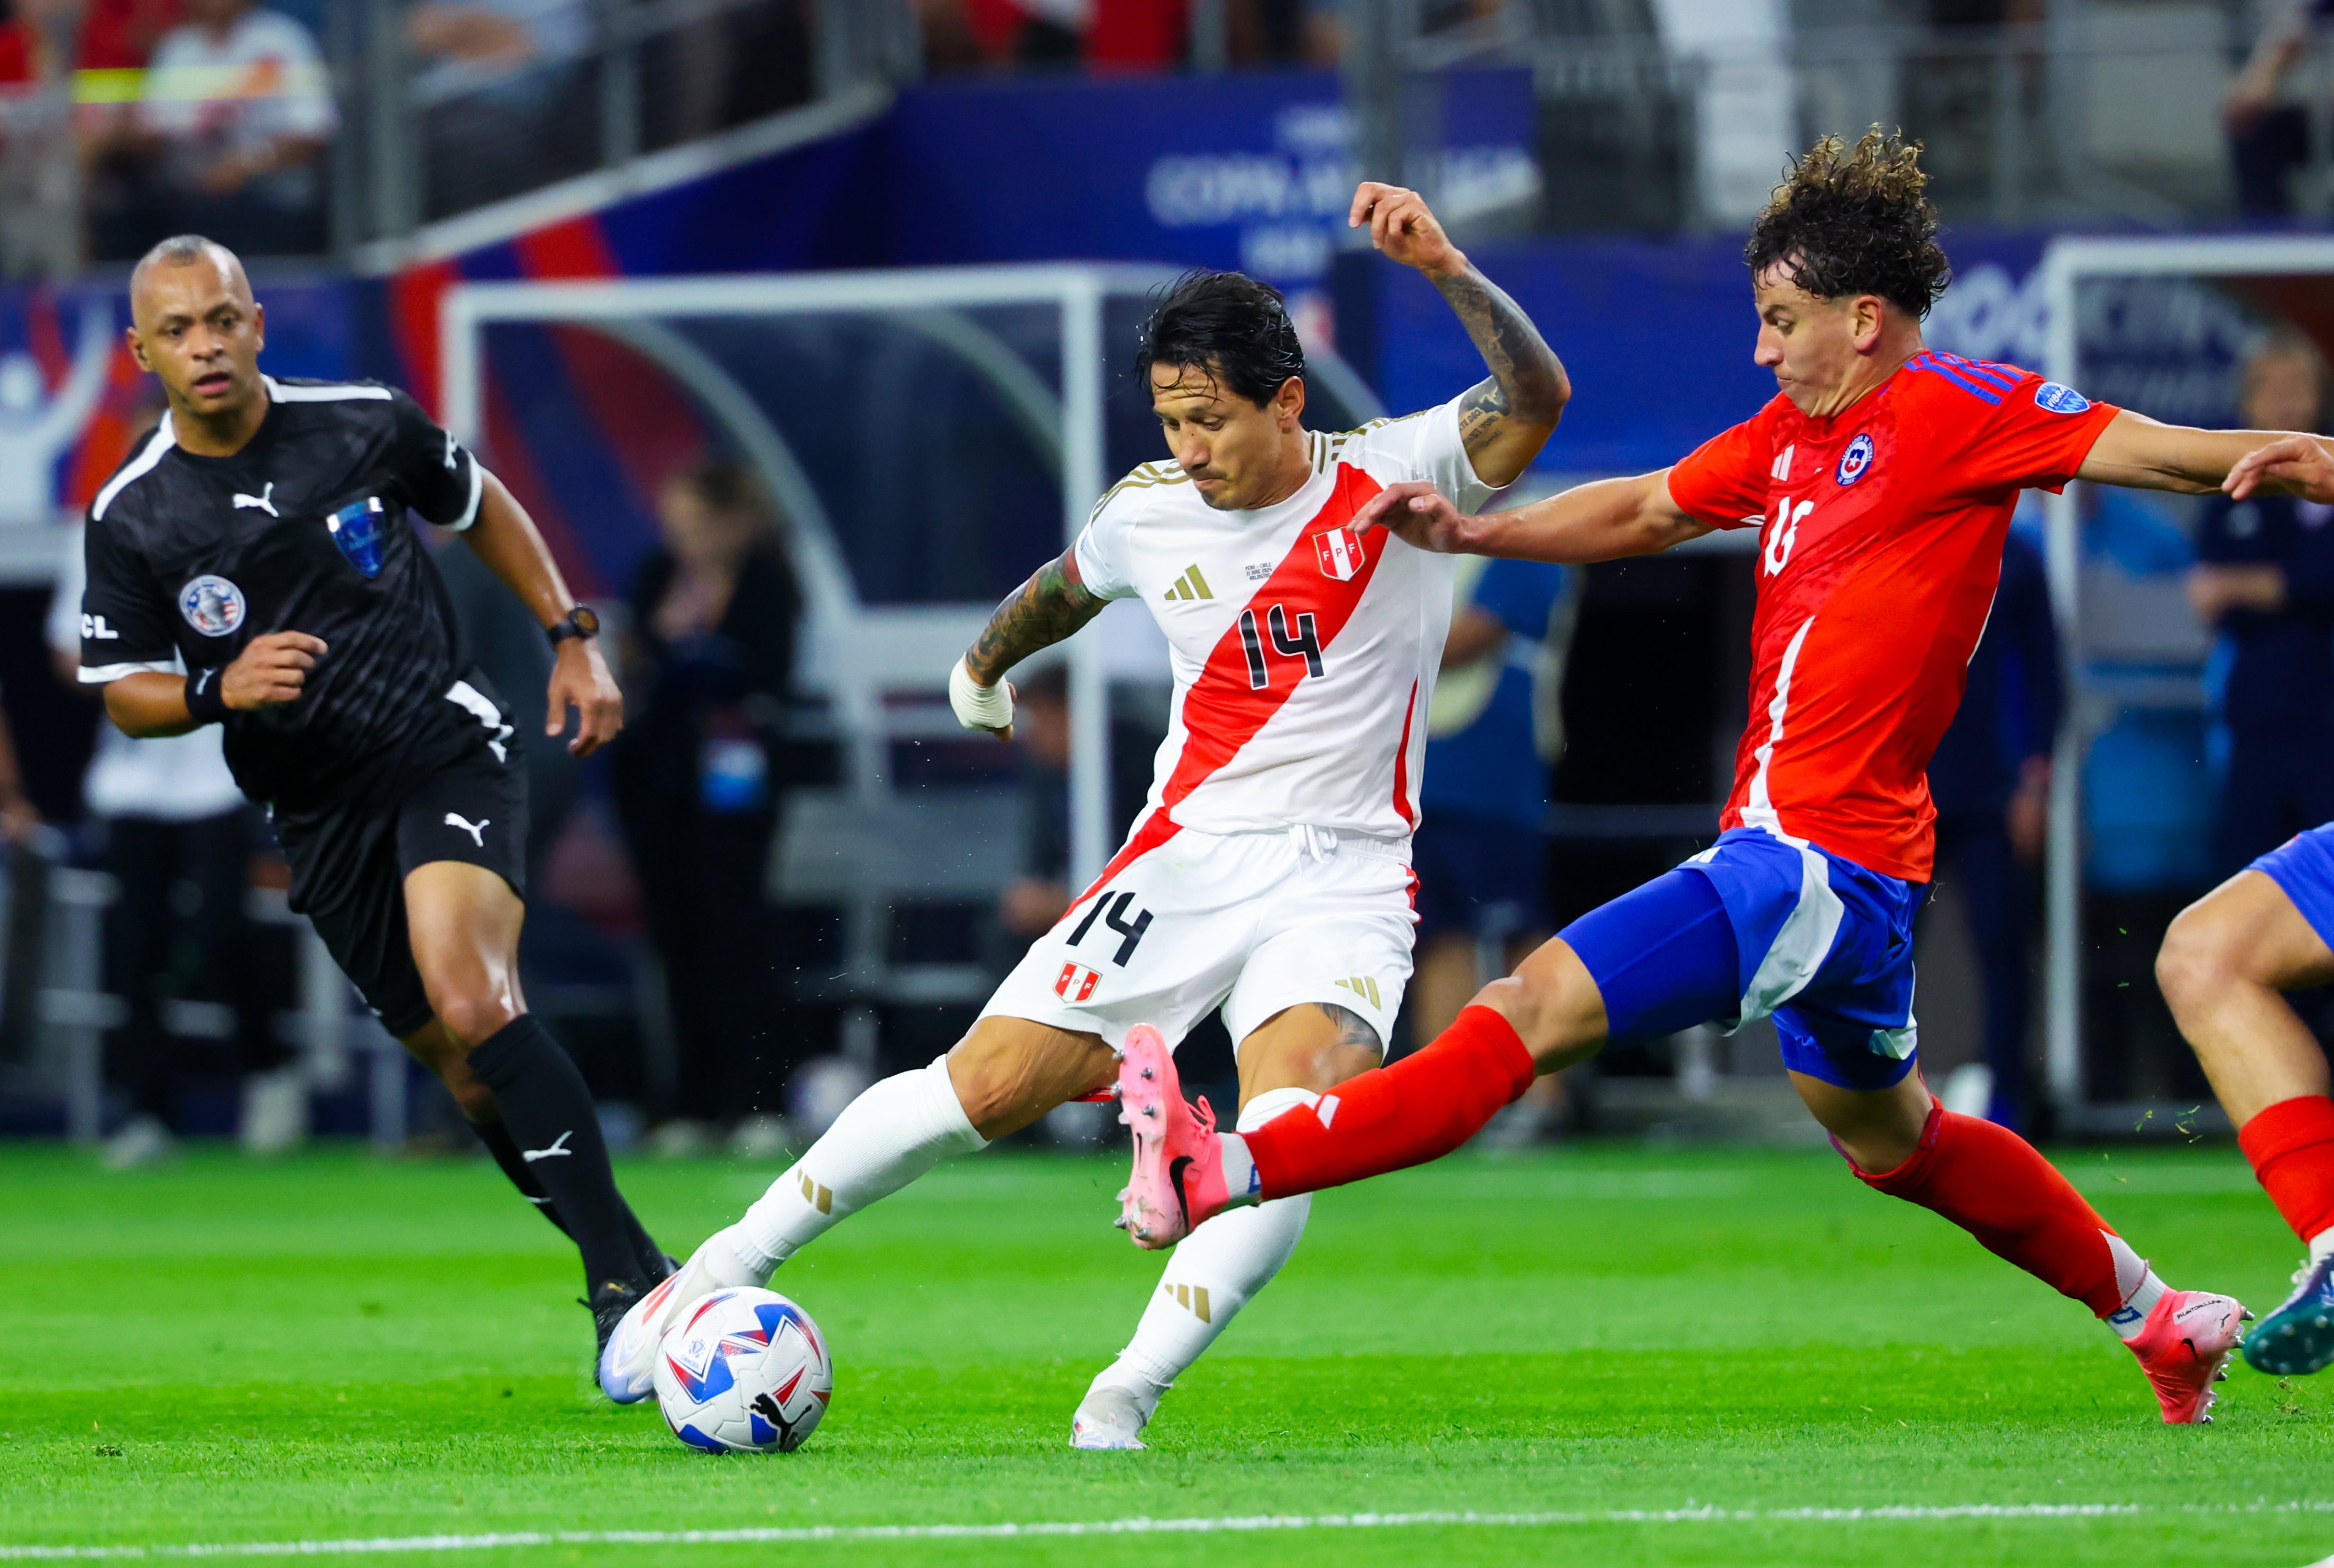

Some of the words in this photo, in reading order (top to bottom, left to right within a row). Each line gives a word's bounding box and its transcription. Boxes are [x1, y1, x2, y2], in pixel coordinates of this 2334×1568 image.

[2046, 386, 2068, 407] VIBRA
[1239, 604, 1326, 690] 14
[1065, 890, 1154, 968] 14
